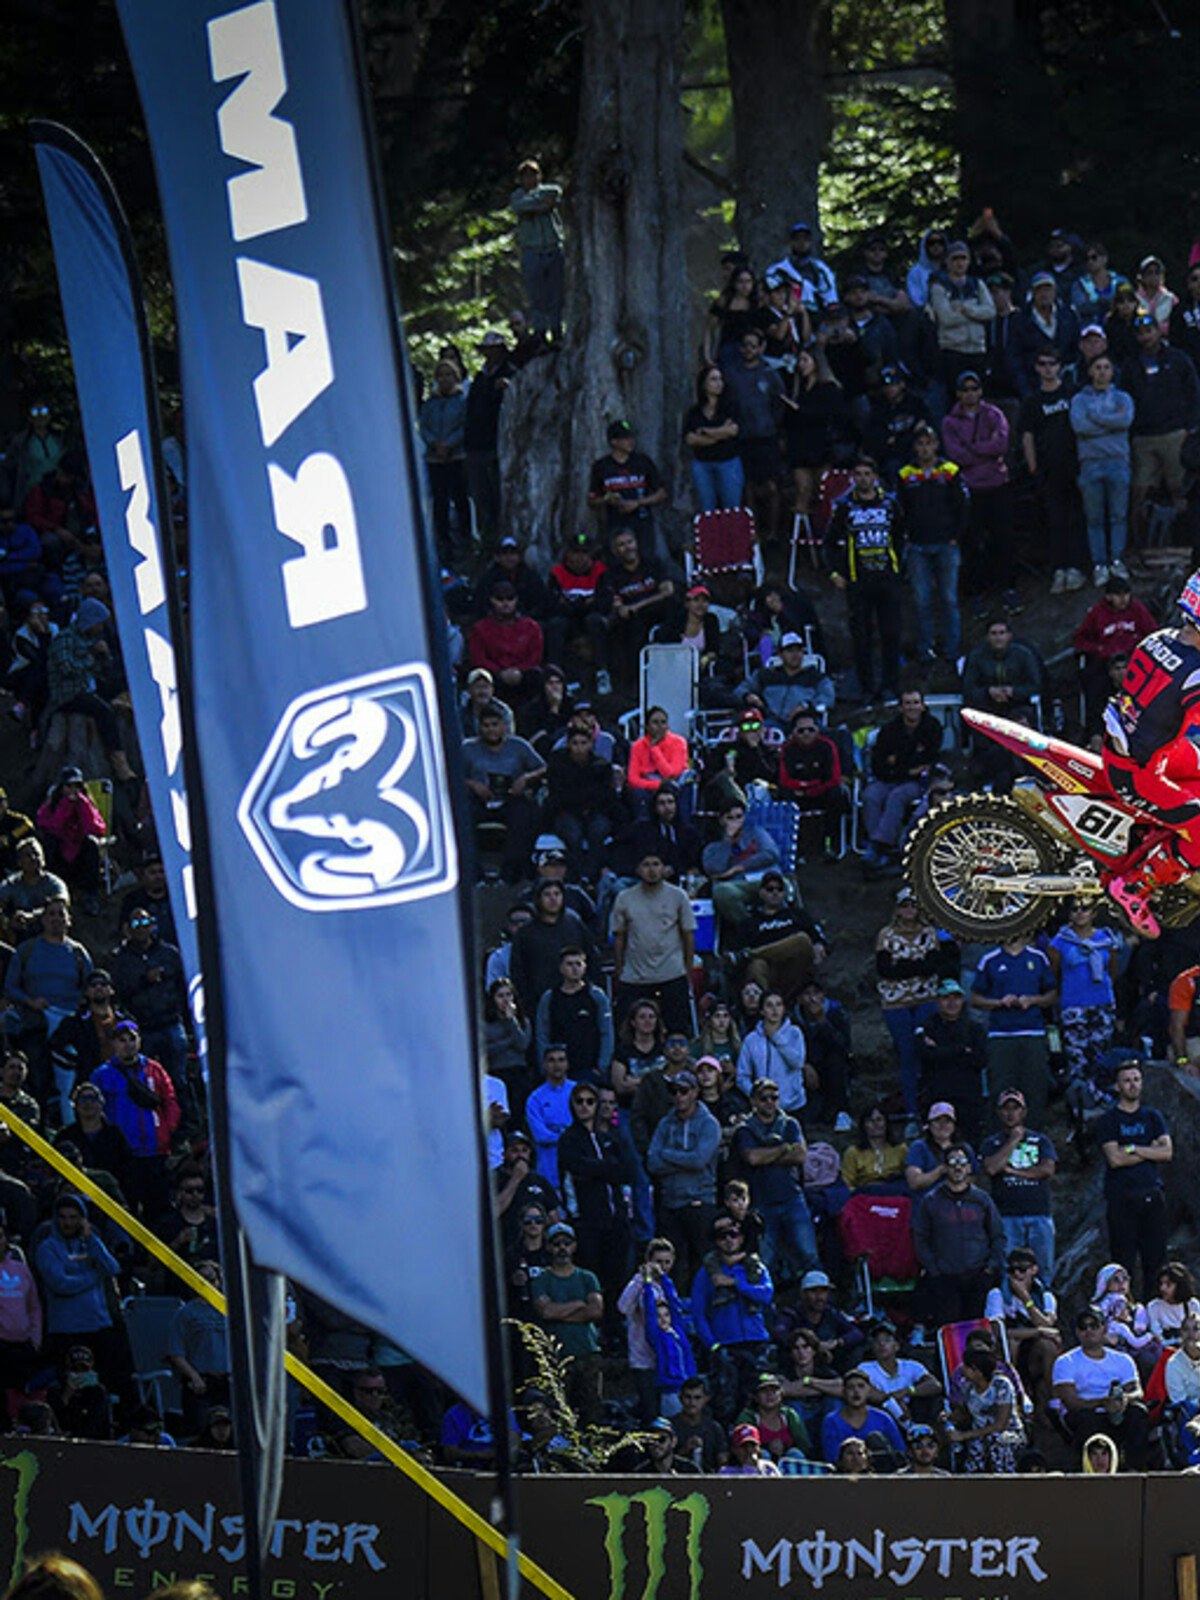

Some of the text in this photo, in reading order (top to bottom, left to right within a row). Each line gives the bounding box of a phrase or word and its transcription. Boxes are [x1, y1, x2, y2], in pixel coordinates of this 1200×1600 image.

[1122, 648, 1174, 708] 61
[1075, 803, 1124, 840] 61
[68, 1498, 387, 1572] MONSTER
[741, 1529, 1048, 1588] MONSTER
